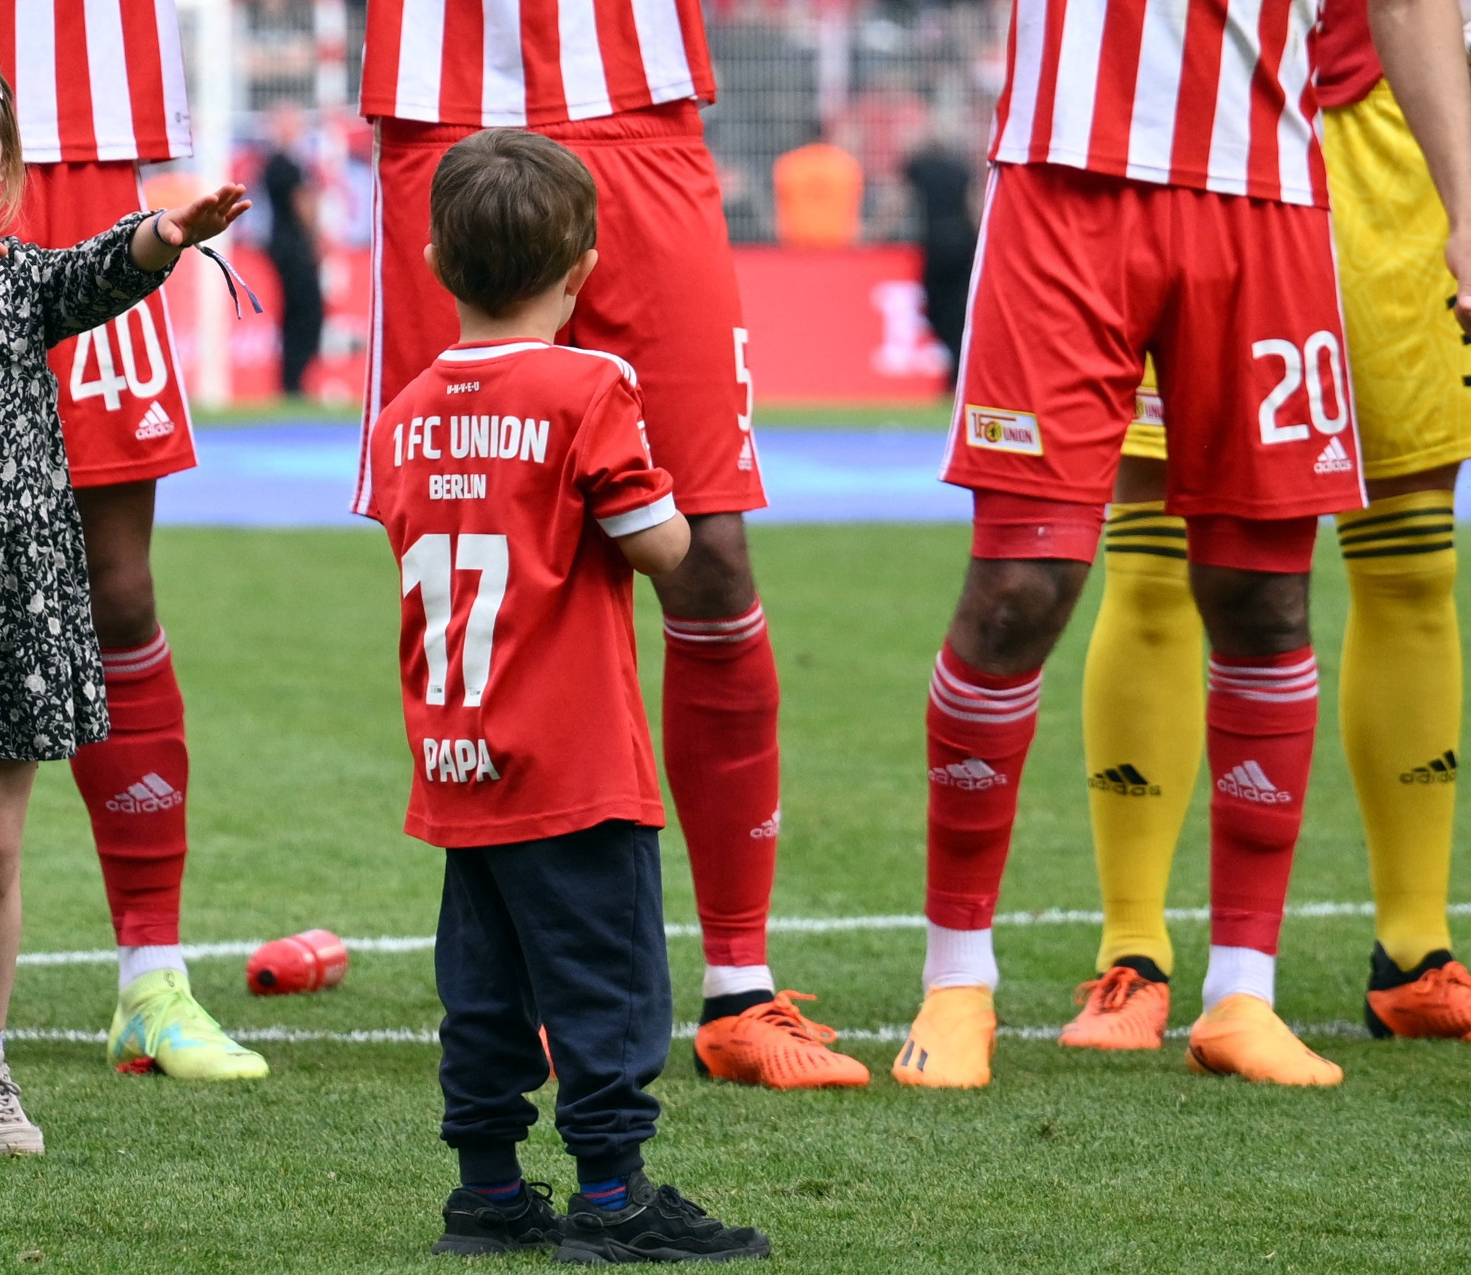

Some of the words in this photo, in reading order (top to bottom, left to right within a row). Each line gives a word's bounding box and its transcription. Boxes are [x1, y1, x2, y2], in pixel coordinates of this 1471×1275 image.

[70, 301, 167, 411] 40
[1252, 331, 1347, 444] 20
[135, 424, 175, 439] adidas
[407, 416, 441, 460] FC
[450, 415, 550, 463] UNION
[1003, 426, 1034, 444] UNION
[1314, 460, 1352, 472] adidas
[429, 473, 486, 500] BERLIN
[401, 533, 510, 707] 17
[423, 738, 501, 782] PAPA
[929, 770, 1008, 790] adidas
[1087, 779, 1161, 796] adidas
[1217, 780, 1291, 803] adidas
[106, 791, 183, 814] adidas
